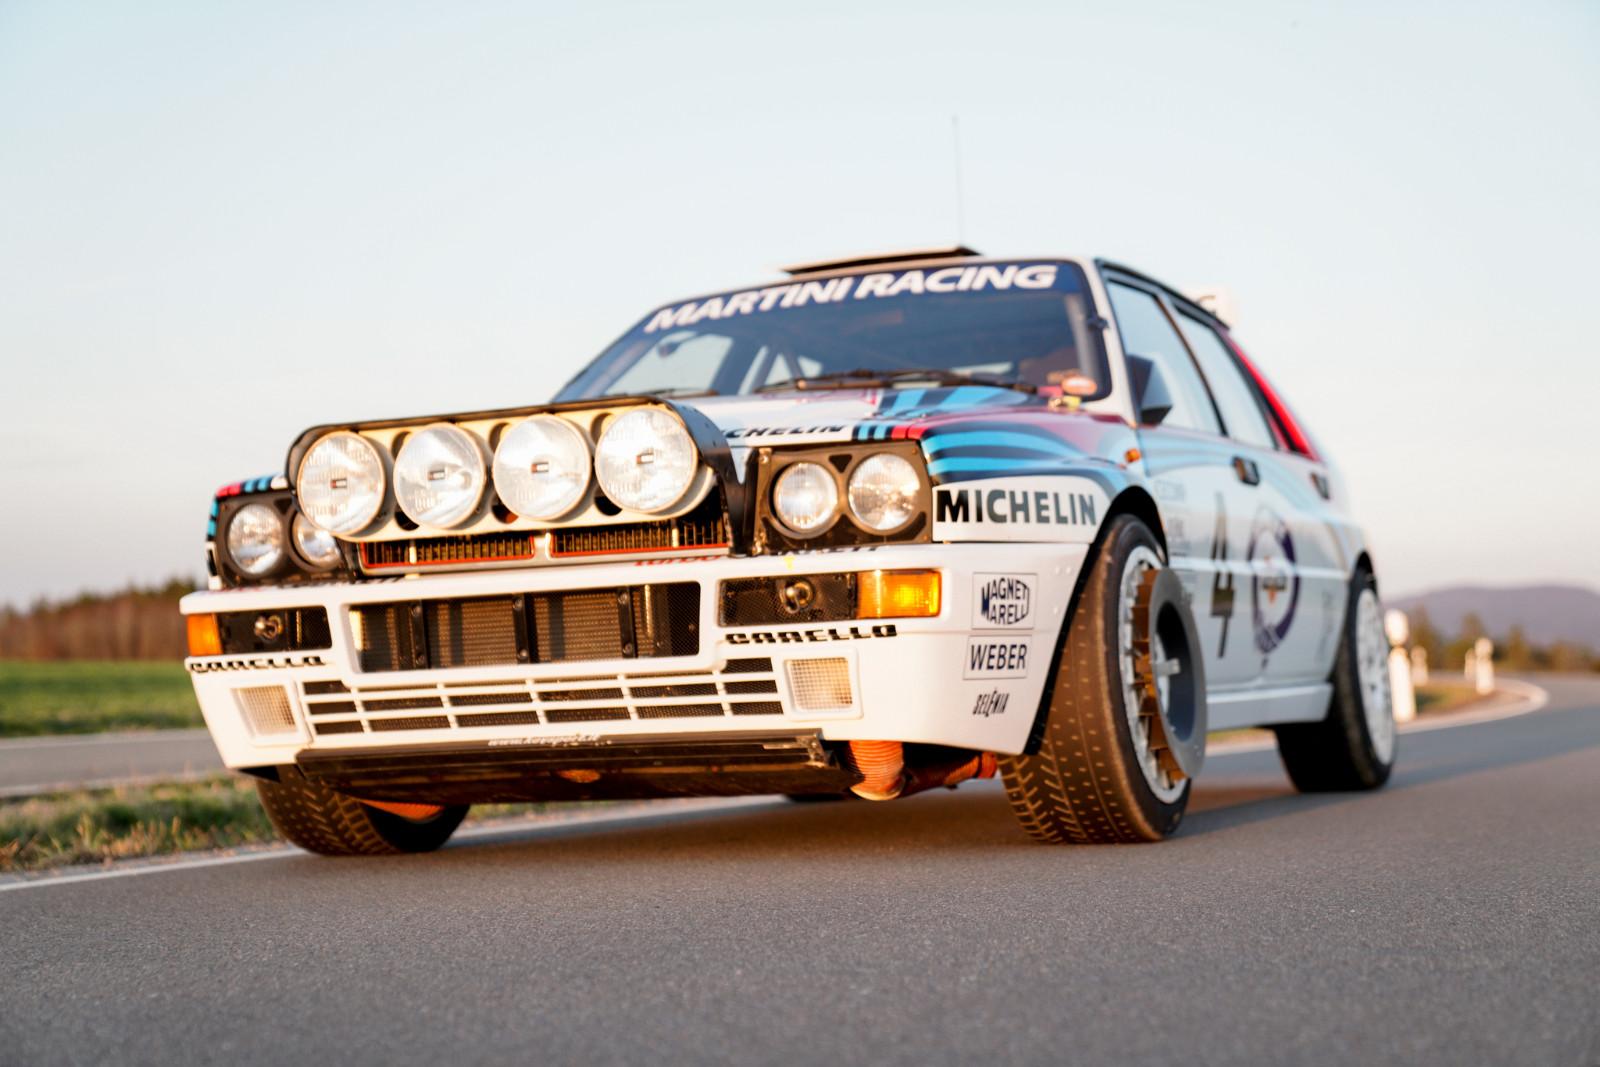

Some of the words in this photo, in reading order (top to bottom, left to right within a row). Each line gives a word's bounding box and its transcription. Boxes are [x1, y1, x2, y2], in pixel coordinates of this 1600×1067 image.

[643, 277, 853, 333] MARTINI
[853, 264, 1058, 299] RACING
[720, 424, 846, 439] CHELIN
[936, 489, 1097, 526] MICHELIN
[970, 644, 1028, 671] WEBER
